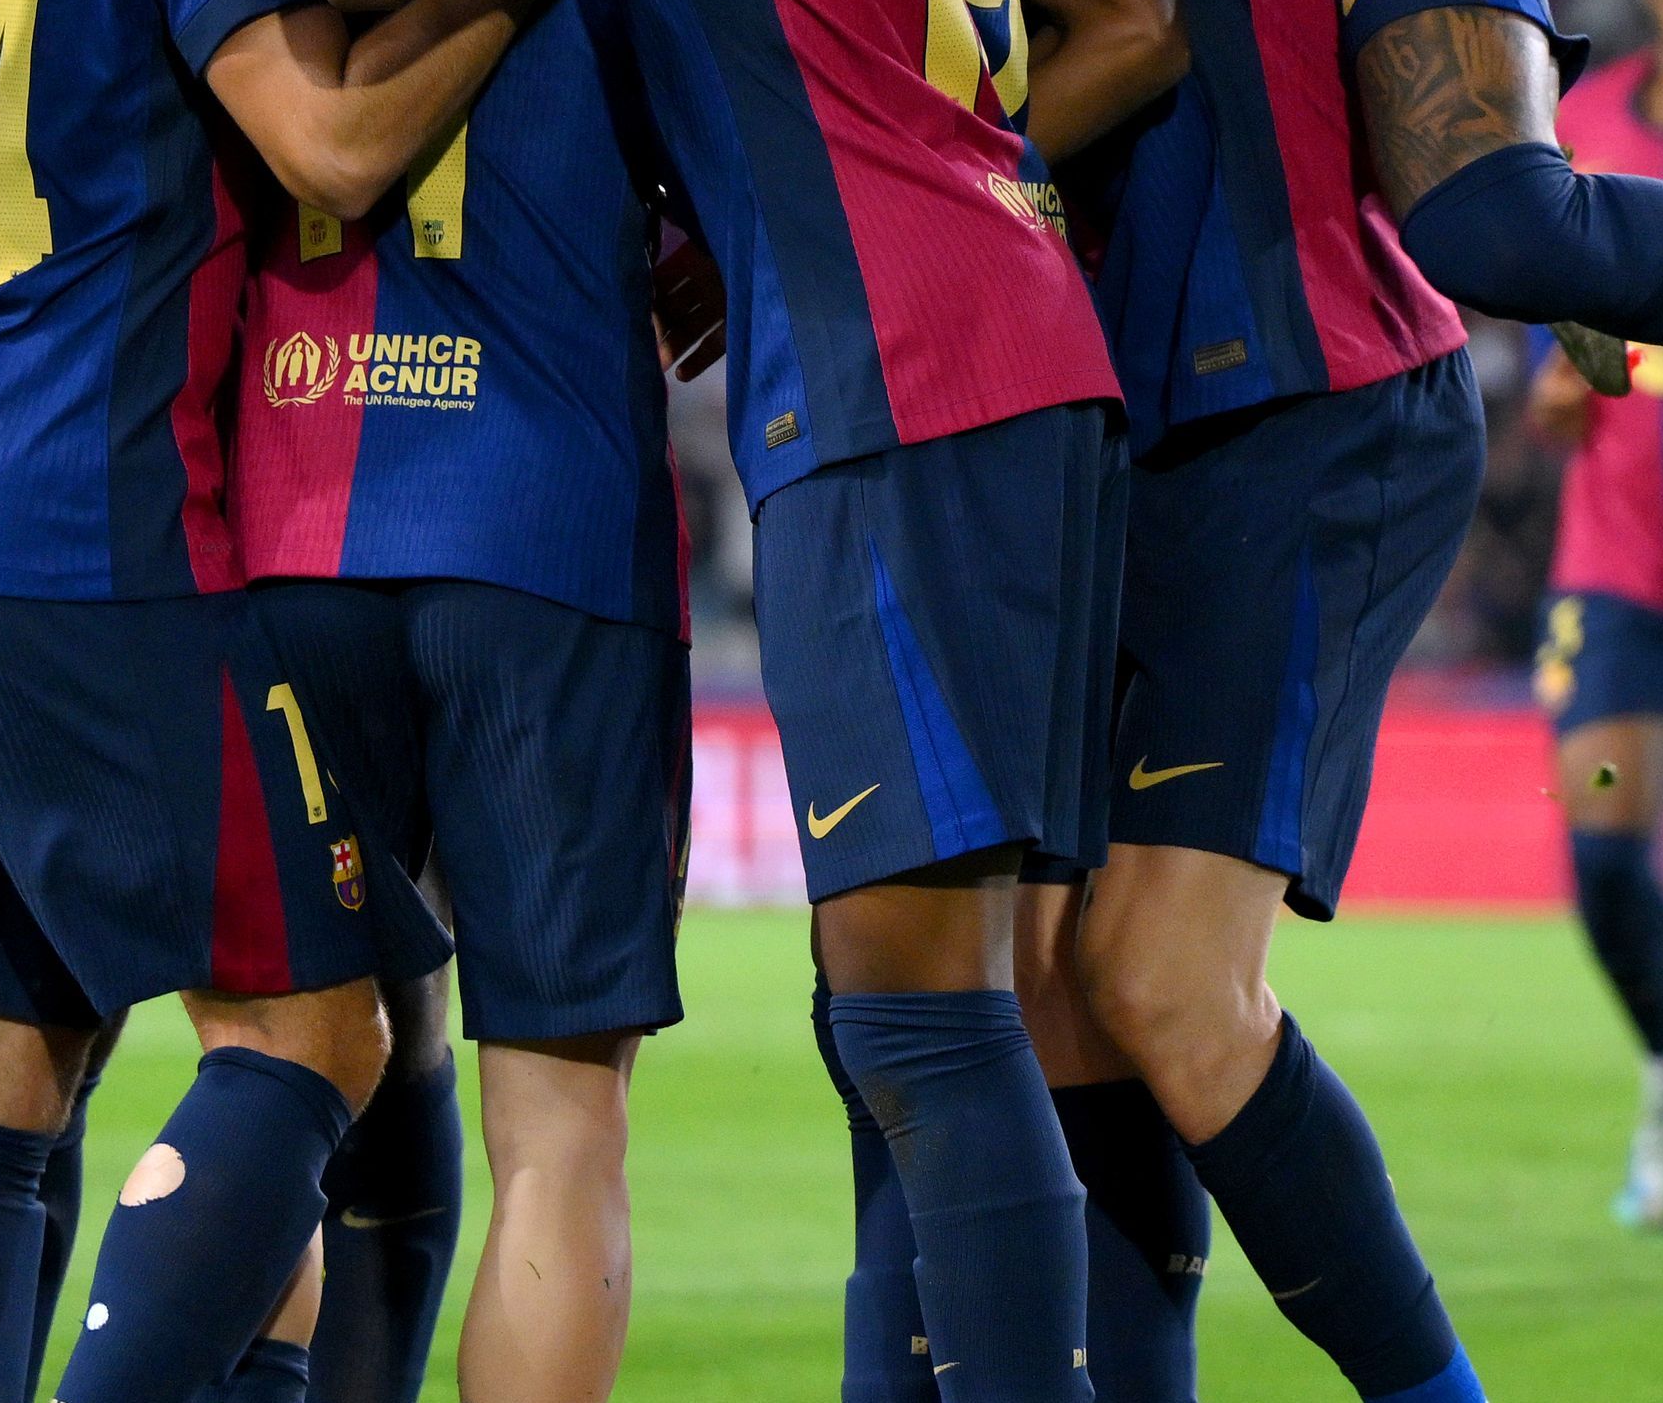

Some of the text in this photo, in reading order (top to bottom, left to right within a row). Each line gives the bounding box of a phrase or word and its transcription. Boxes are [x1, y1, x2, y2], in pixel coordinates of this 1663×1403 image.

[348, 334, 482, 365] UNHCR
[343, 364, 478, 396] ACNUR
[343, 395, 475, 412] The UN Refugee Agency
